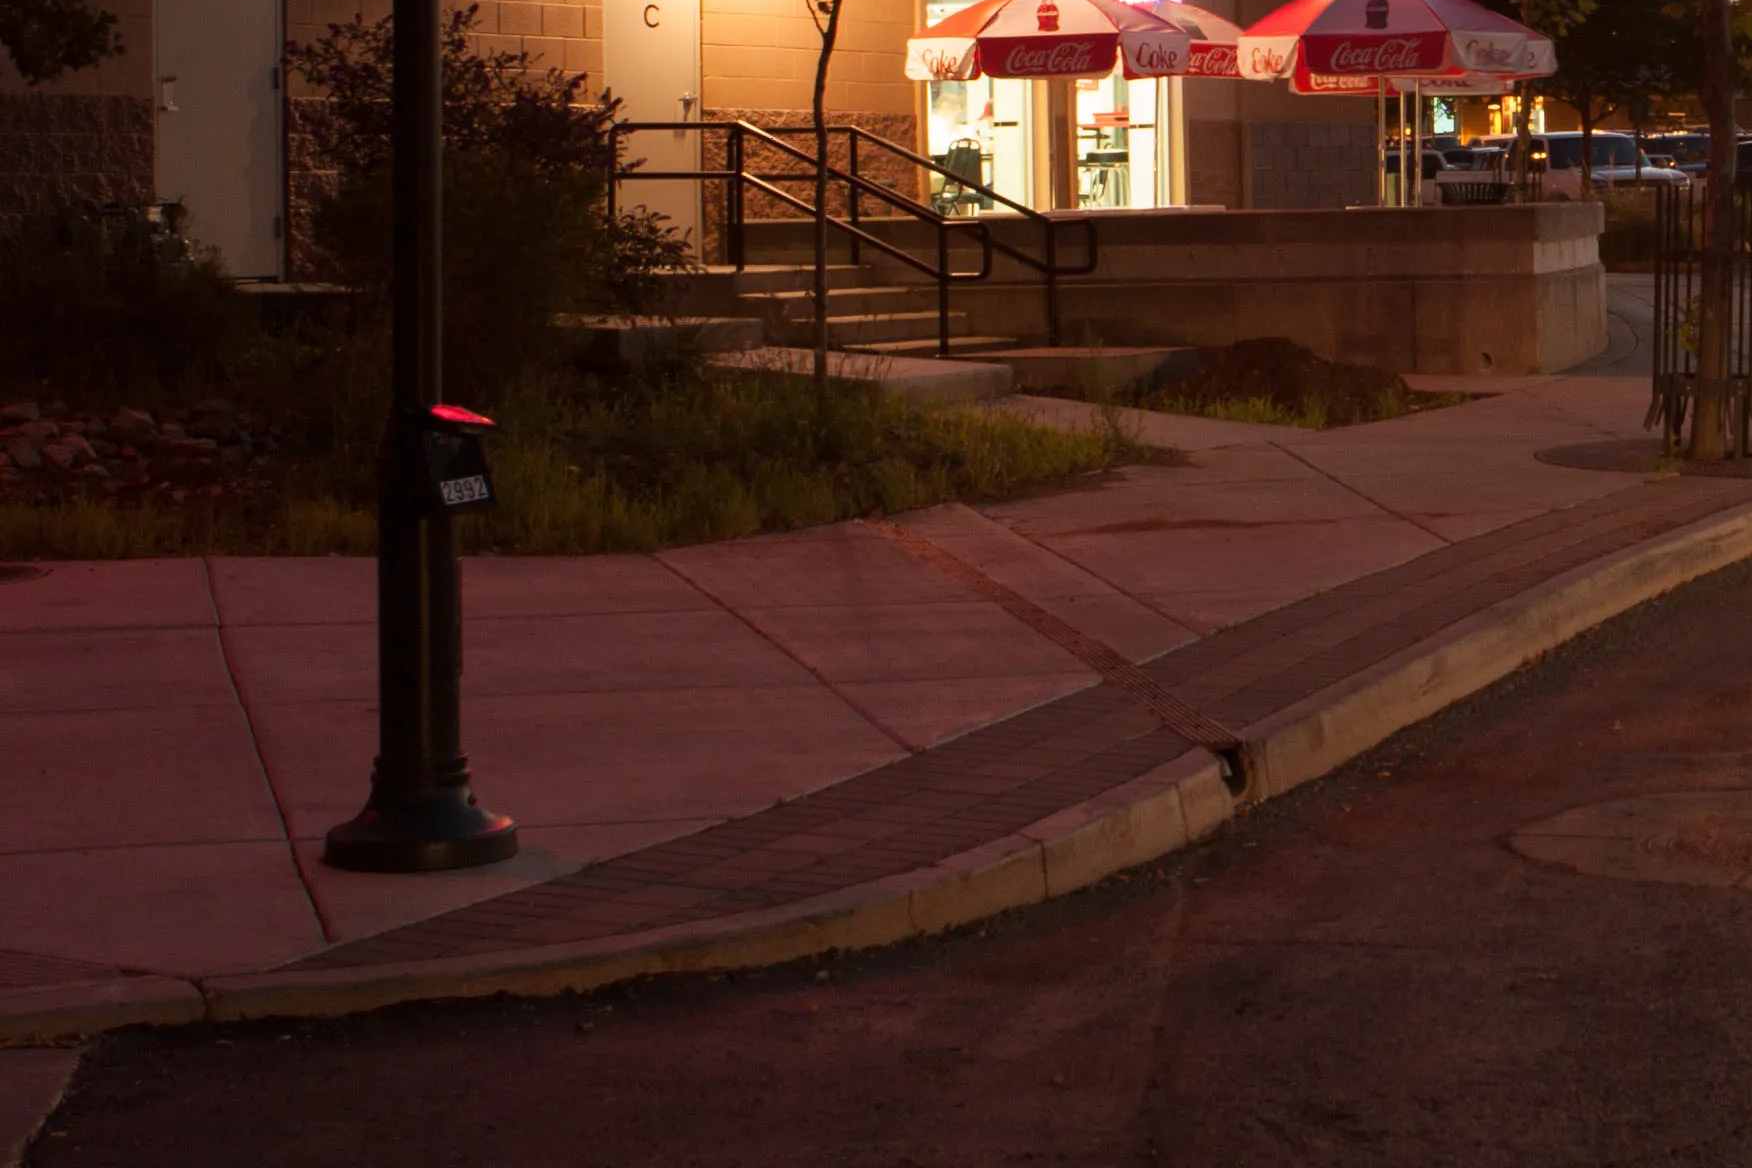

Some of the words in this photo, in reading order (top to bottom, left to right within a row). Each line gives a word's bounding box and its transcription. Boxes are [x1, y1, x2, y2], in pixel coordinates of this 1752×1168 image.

[643, 4, 660, 28] C
[1005, 41, 1095, 74] Coca-Cola
[1135, 42, 1178, 70] Coke
[1330, 38, 1424, 72] Coca-Cola
[442, 477, 486, 503] 2992
